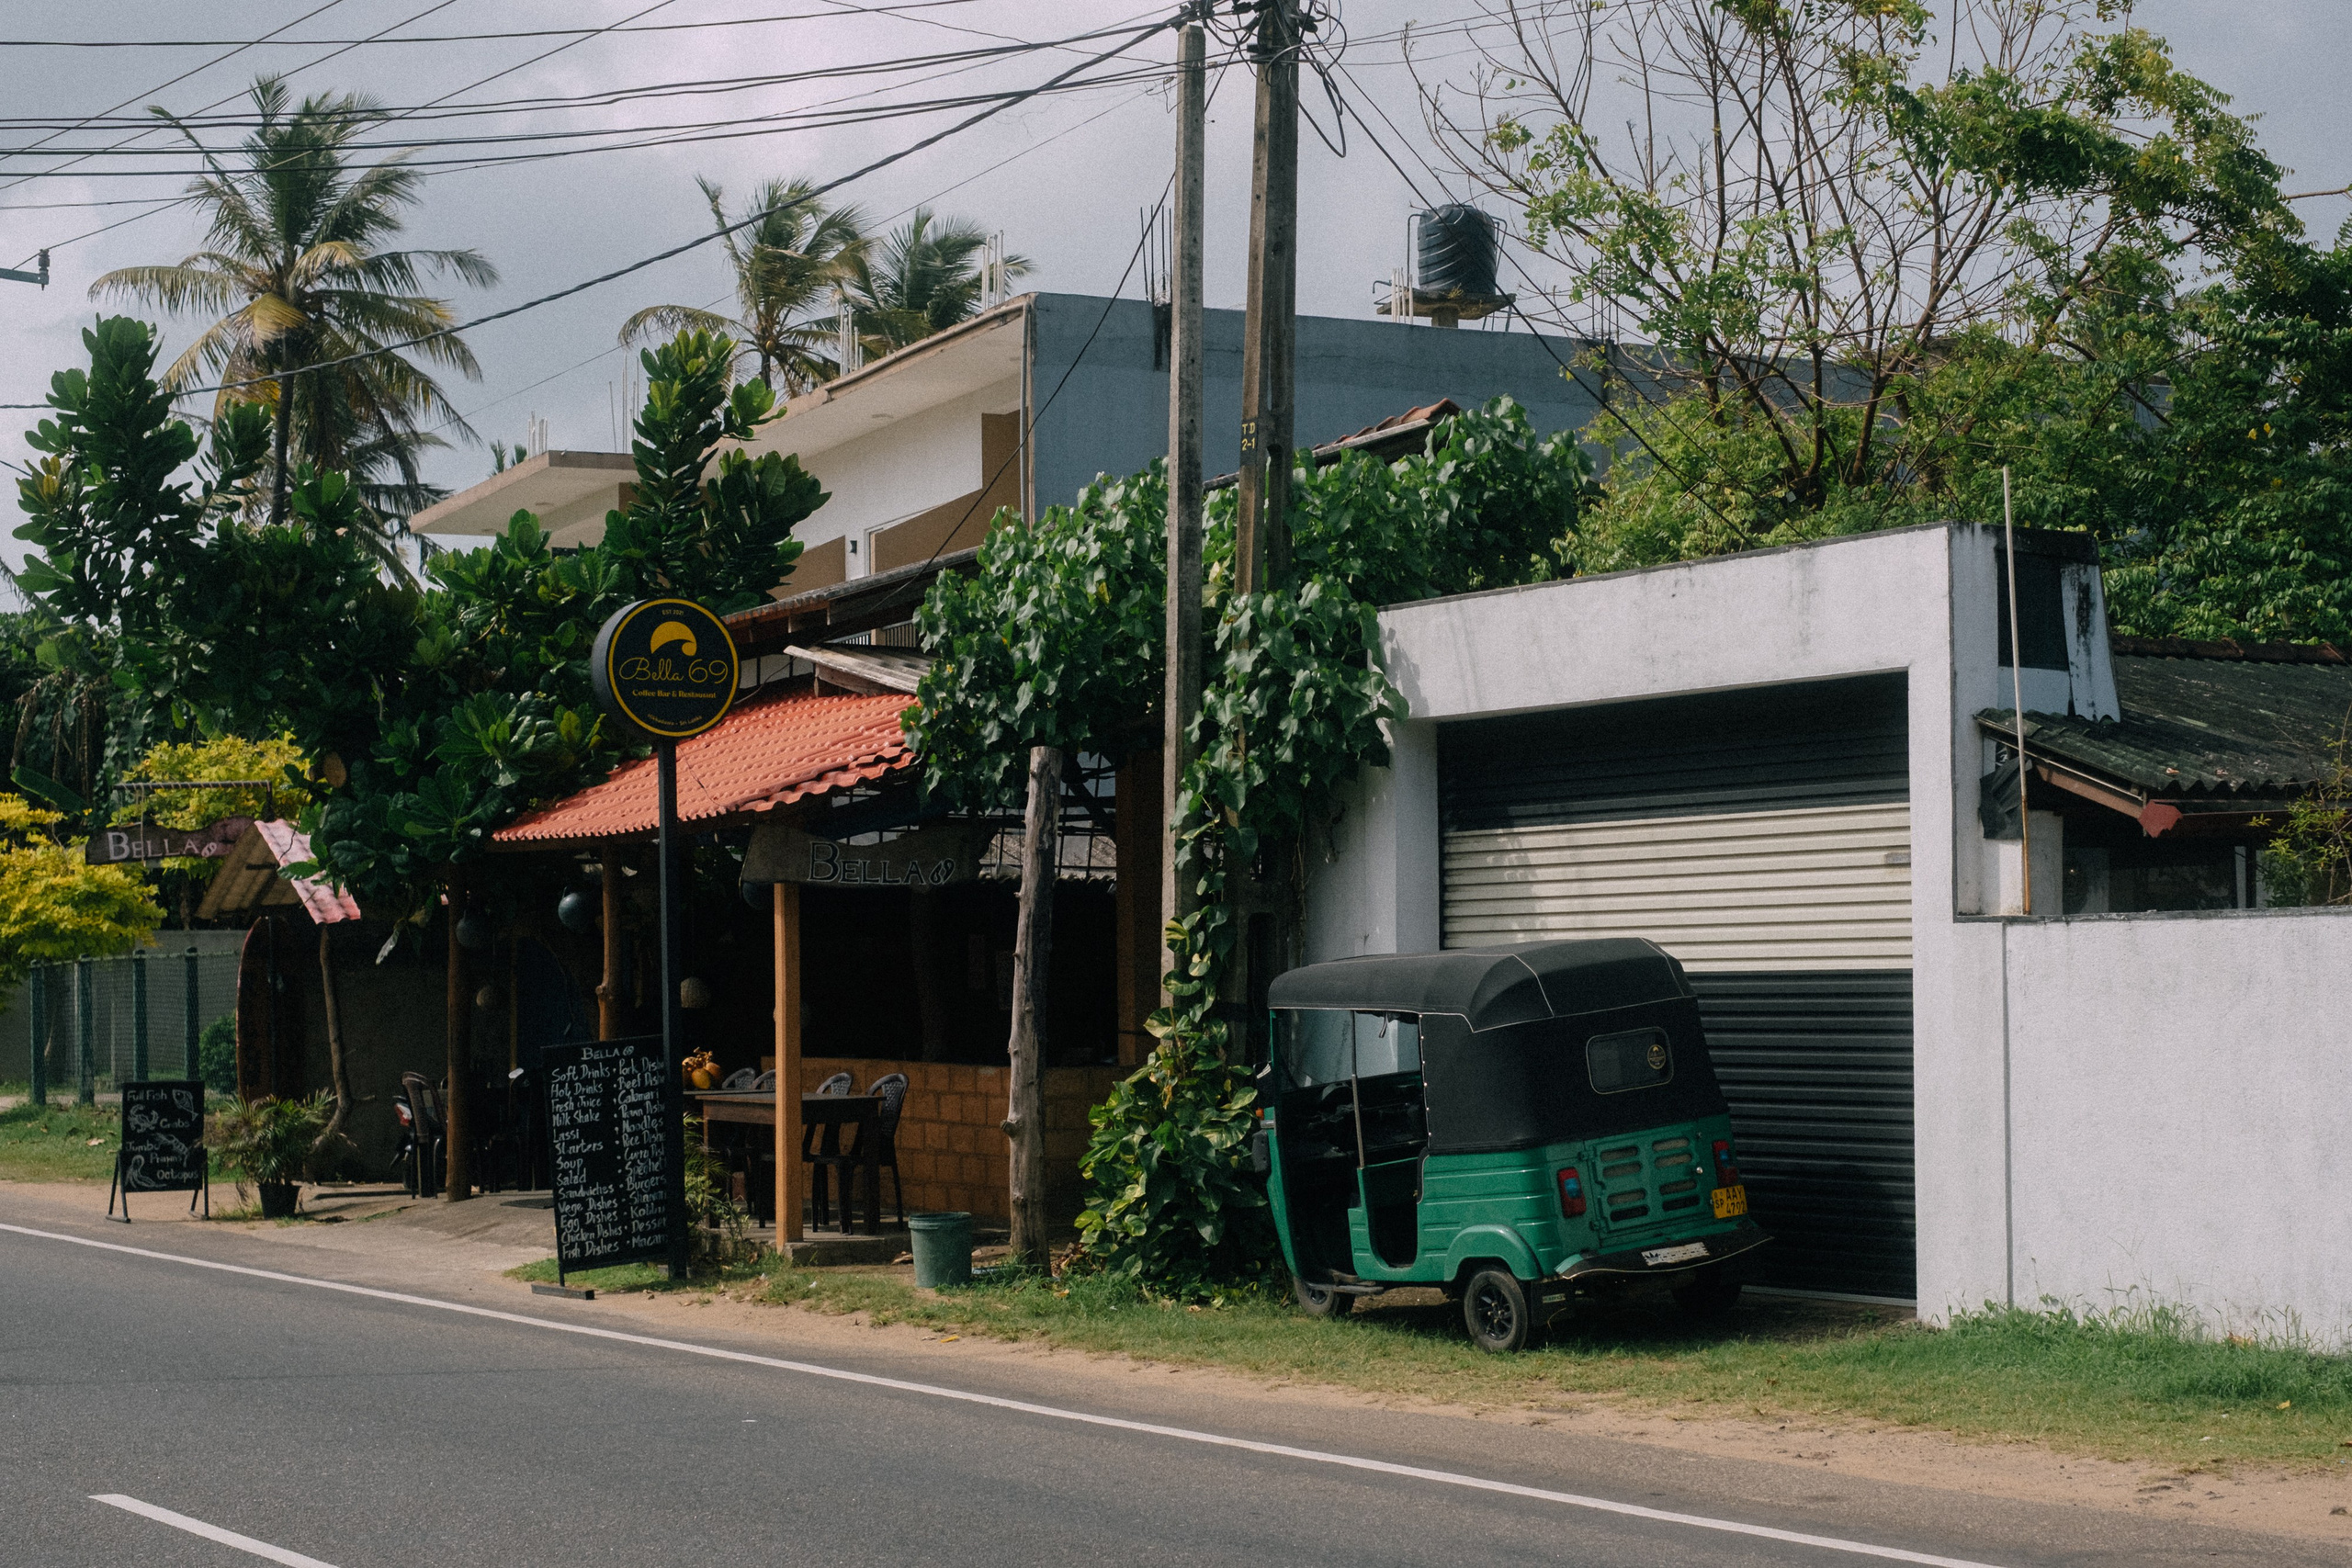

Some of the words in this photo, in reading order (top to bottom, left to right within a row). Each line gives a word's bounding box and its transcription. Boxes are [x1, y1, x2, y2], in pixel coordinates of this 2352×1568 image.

[1241, 422, 1256, 435] TD
[1241, 437, 1256, 451] 2-1
[618, 657, 684, 682] Bella
[688, 659, 729, 684] 69
[657, 690, 670, 698] Bar
[678, 691, 717, 699] Restaurant
[107, 830, 199, 861] BELLA
[807, 840, 927, 886] BELLA
[929, 857, 956, 886] 69
[581, 1047, 620, 1061] BELLA
[551, 1066, 579, 1083] Soft
[580, 1062, 611, 1080] Drinks
[618, 1057, 639, 1076] Pork
[641, 1056, 665, 1073] Dishe
[573, 1079, 603, 1096] Drinks
[616, 1072, 642, 1090] Beef
[644, 1070, 665, 1087] Dishe
[127, 1089, 143, 1101] Full
[146, 1089, 167, 1100] Fish
[551, 1097, 574, 1113] Fresh
[577, 1095, 602, 1109] Juice
[644, 1100, 665, 1115] Dishe
[552, 1112, 571, 1127] Milk
[573, 1108, 600, 1122] Shake
[622, 1114, 664, 1134] Noodles
[553, 1128, 580, 1144] Lassi
[621, 1132, 640, 1148] Rice
[642, 1129, 666, 1145] Dishe
[125, 1140, 161, 1152] Jumbo
[156, 1168, 198, 1183] Octopus
[556, 1156, 583, 1176] Soup
[557, 1168, 587, 1187] Salad
[626, 1173, 667, 1193] Burgers
[558, 1181, 615, 1201] Sandwiches
[586, 1195, 618, 1212] Dishes
[1715, 1199, 1724, 1209] SP
[560, 1214, 581, 1234] Egg
[584, 1210, 618, 1225] Dishes
[596, 1223, 623, 1239] Dishes
[561, 1242, 581, 1260] Fish
[584, 1237, 619, 1258] Dishes
